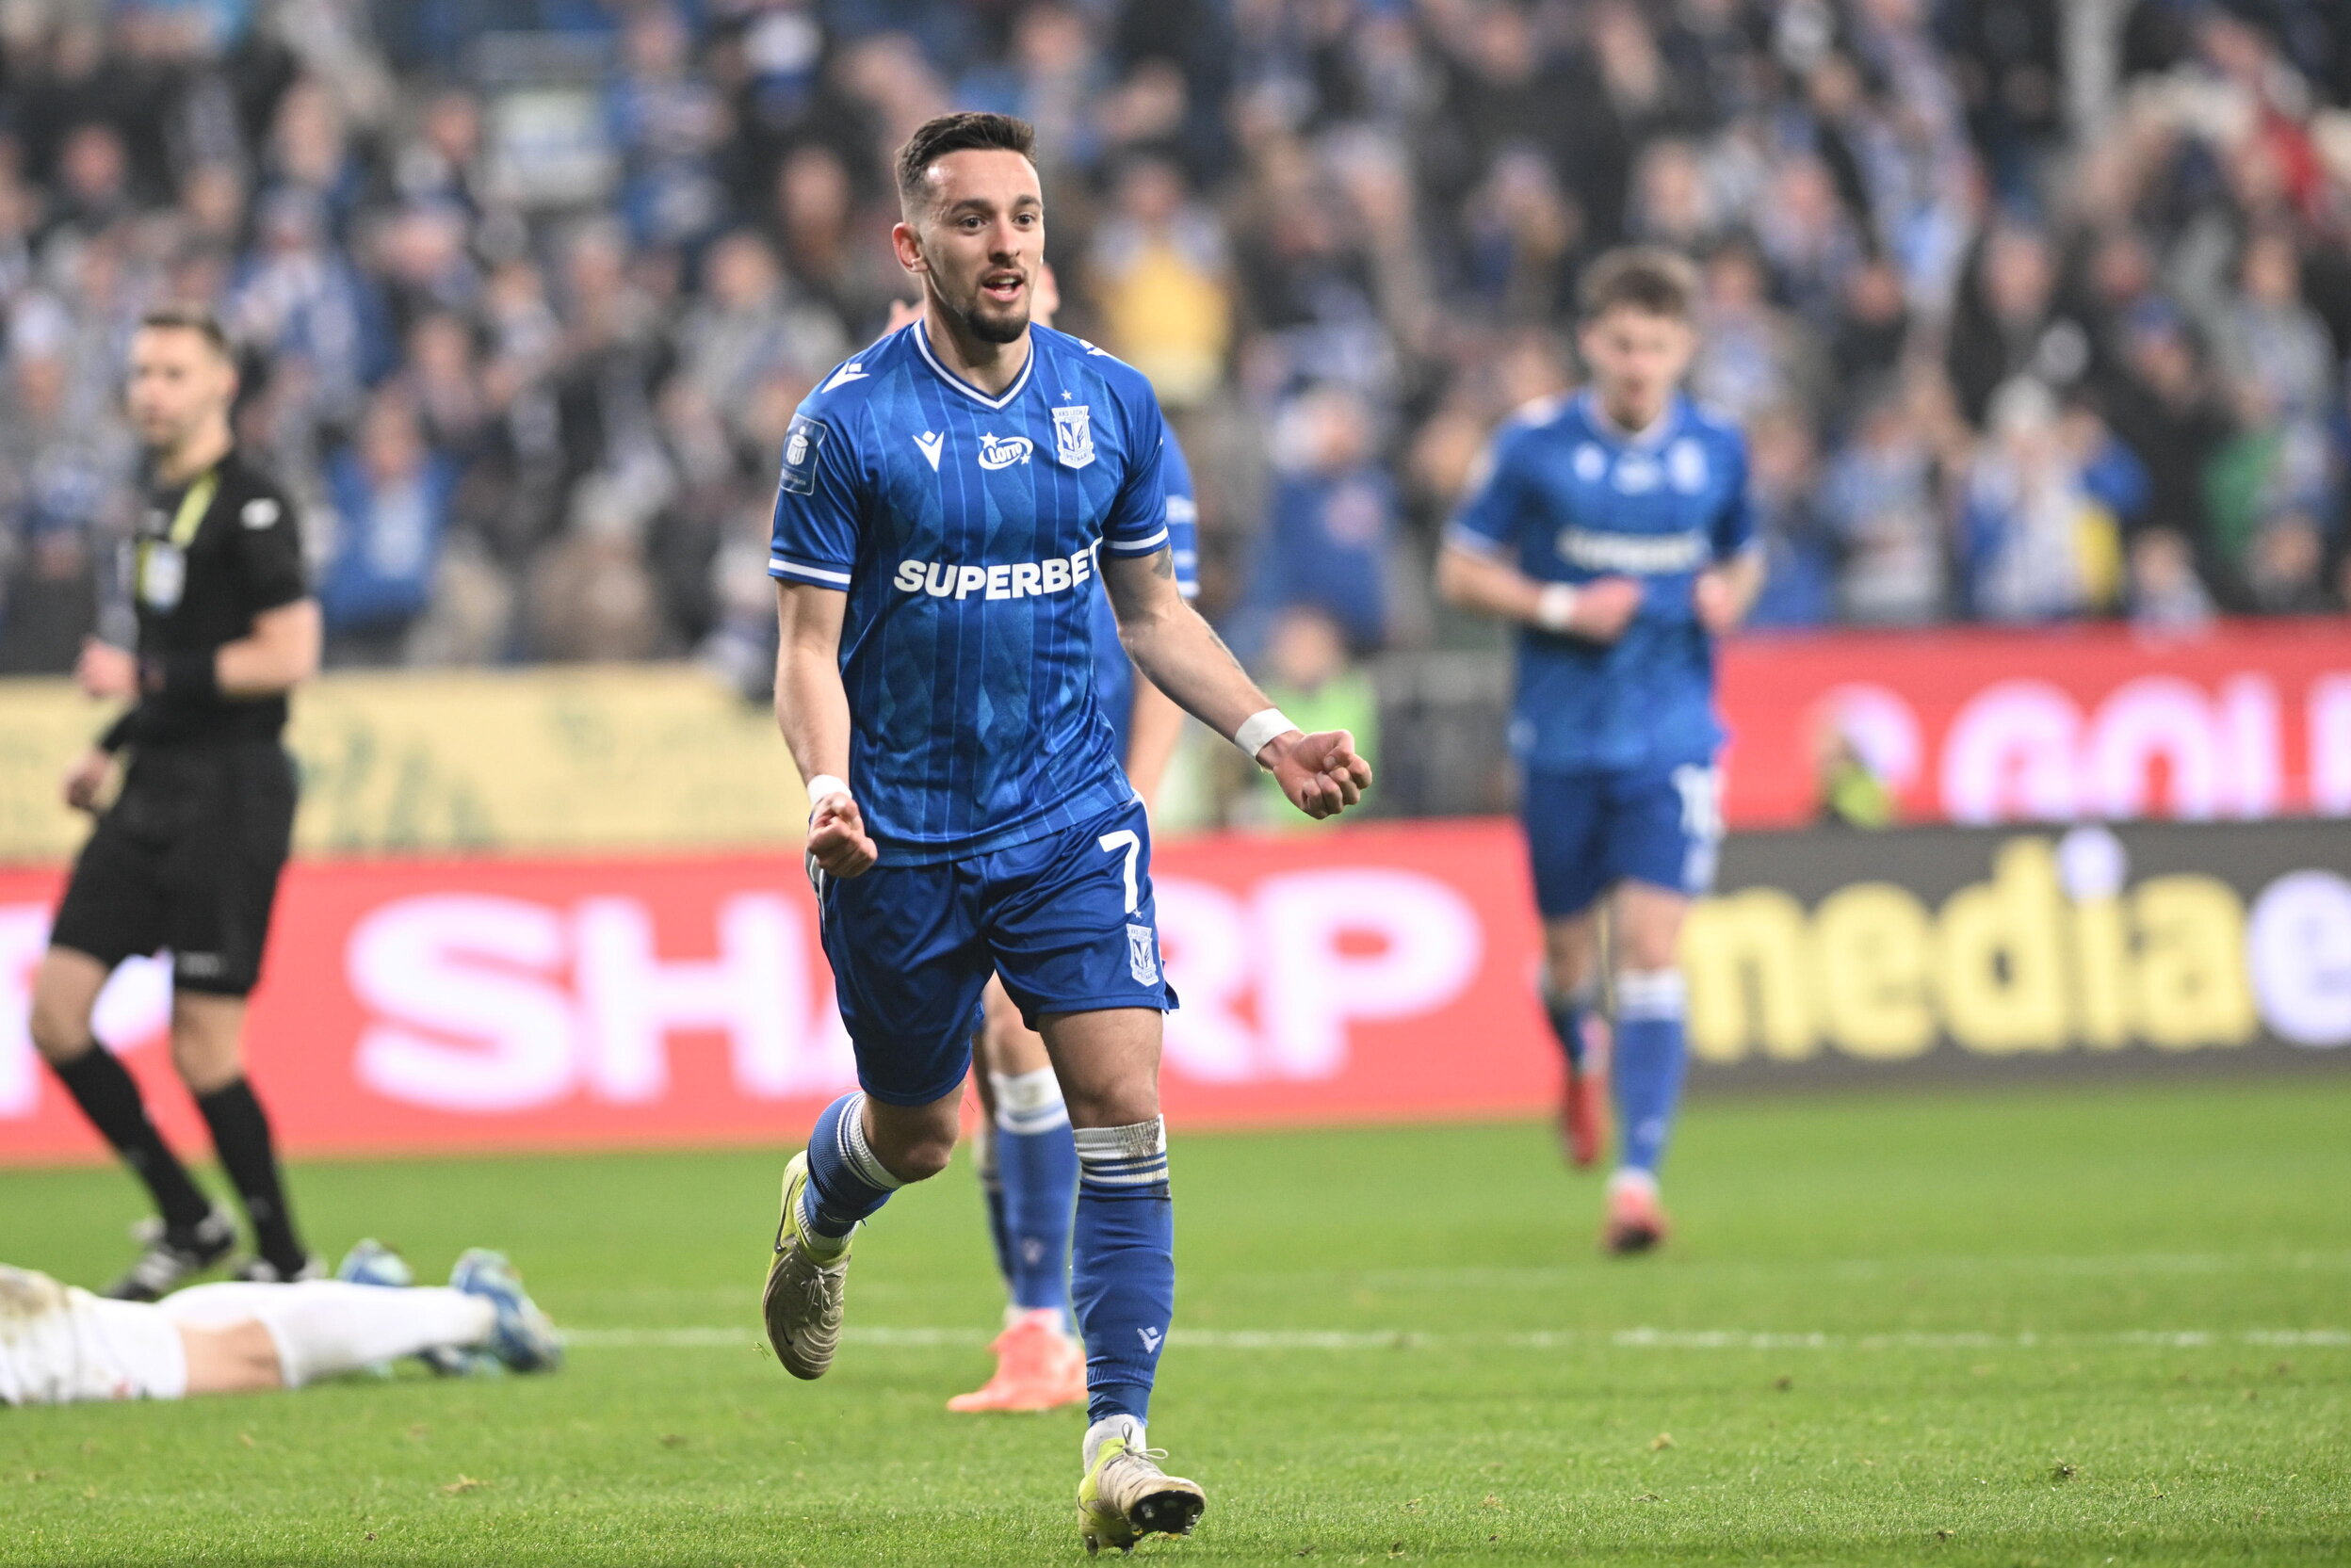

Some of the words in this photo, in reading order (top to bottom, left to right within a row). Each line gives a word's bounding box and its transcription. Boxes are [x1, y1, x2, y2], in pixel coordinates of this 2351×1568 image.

[987, 442, 1023, 463] LOTTO
[893, 536, 1103, 600] SUPERBET
[1098, 830, 1140, 913] 7
[347, 870, 1483, 1109] SHRP
